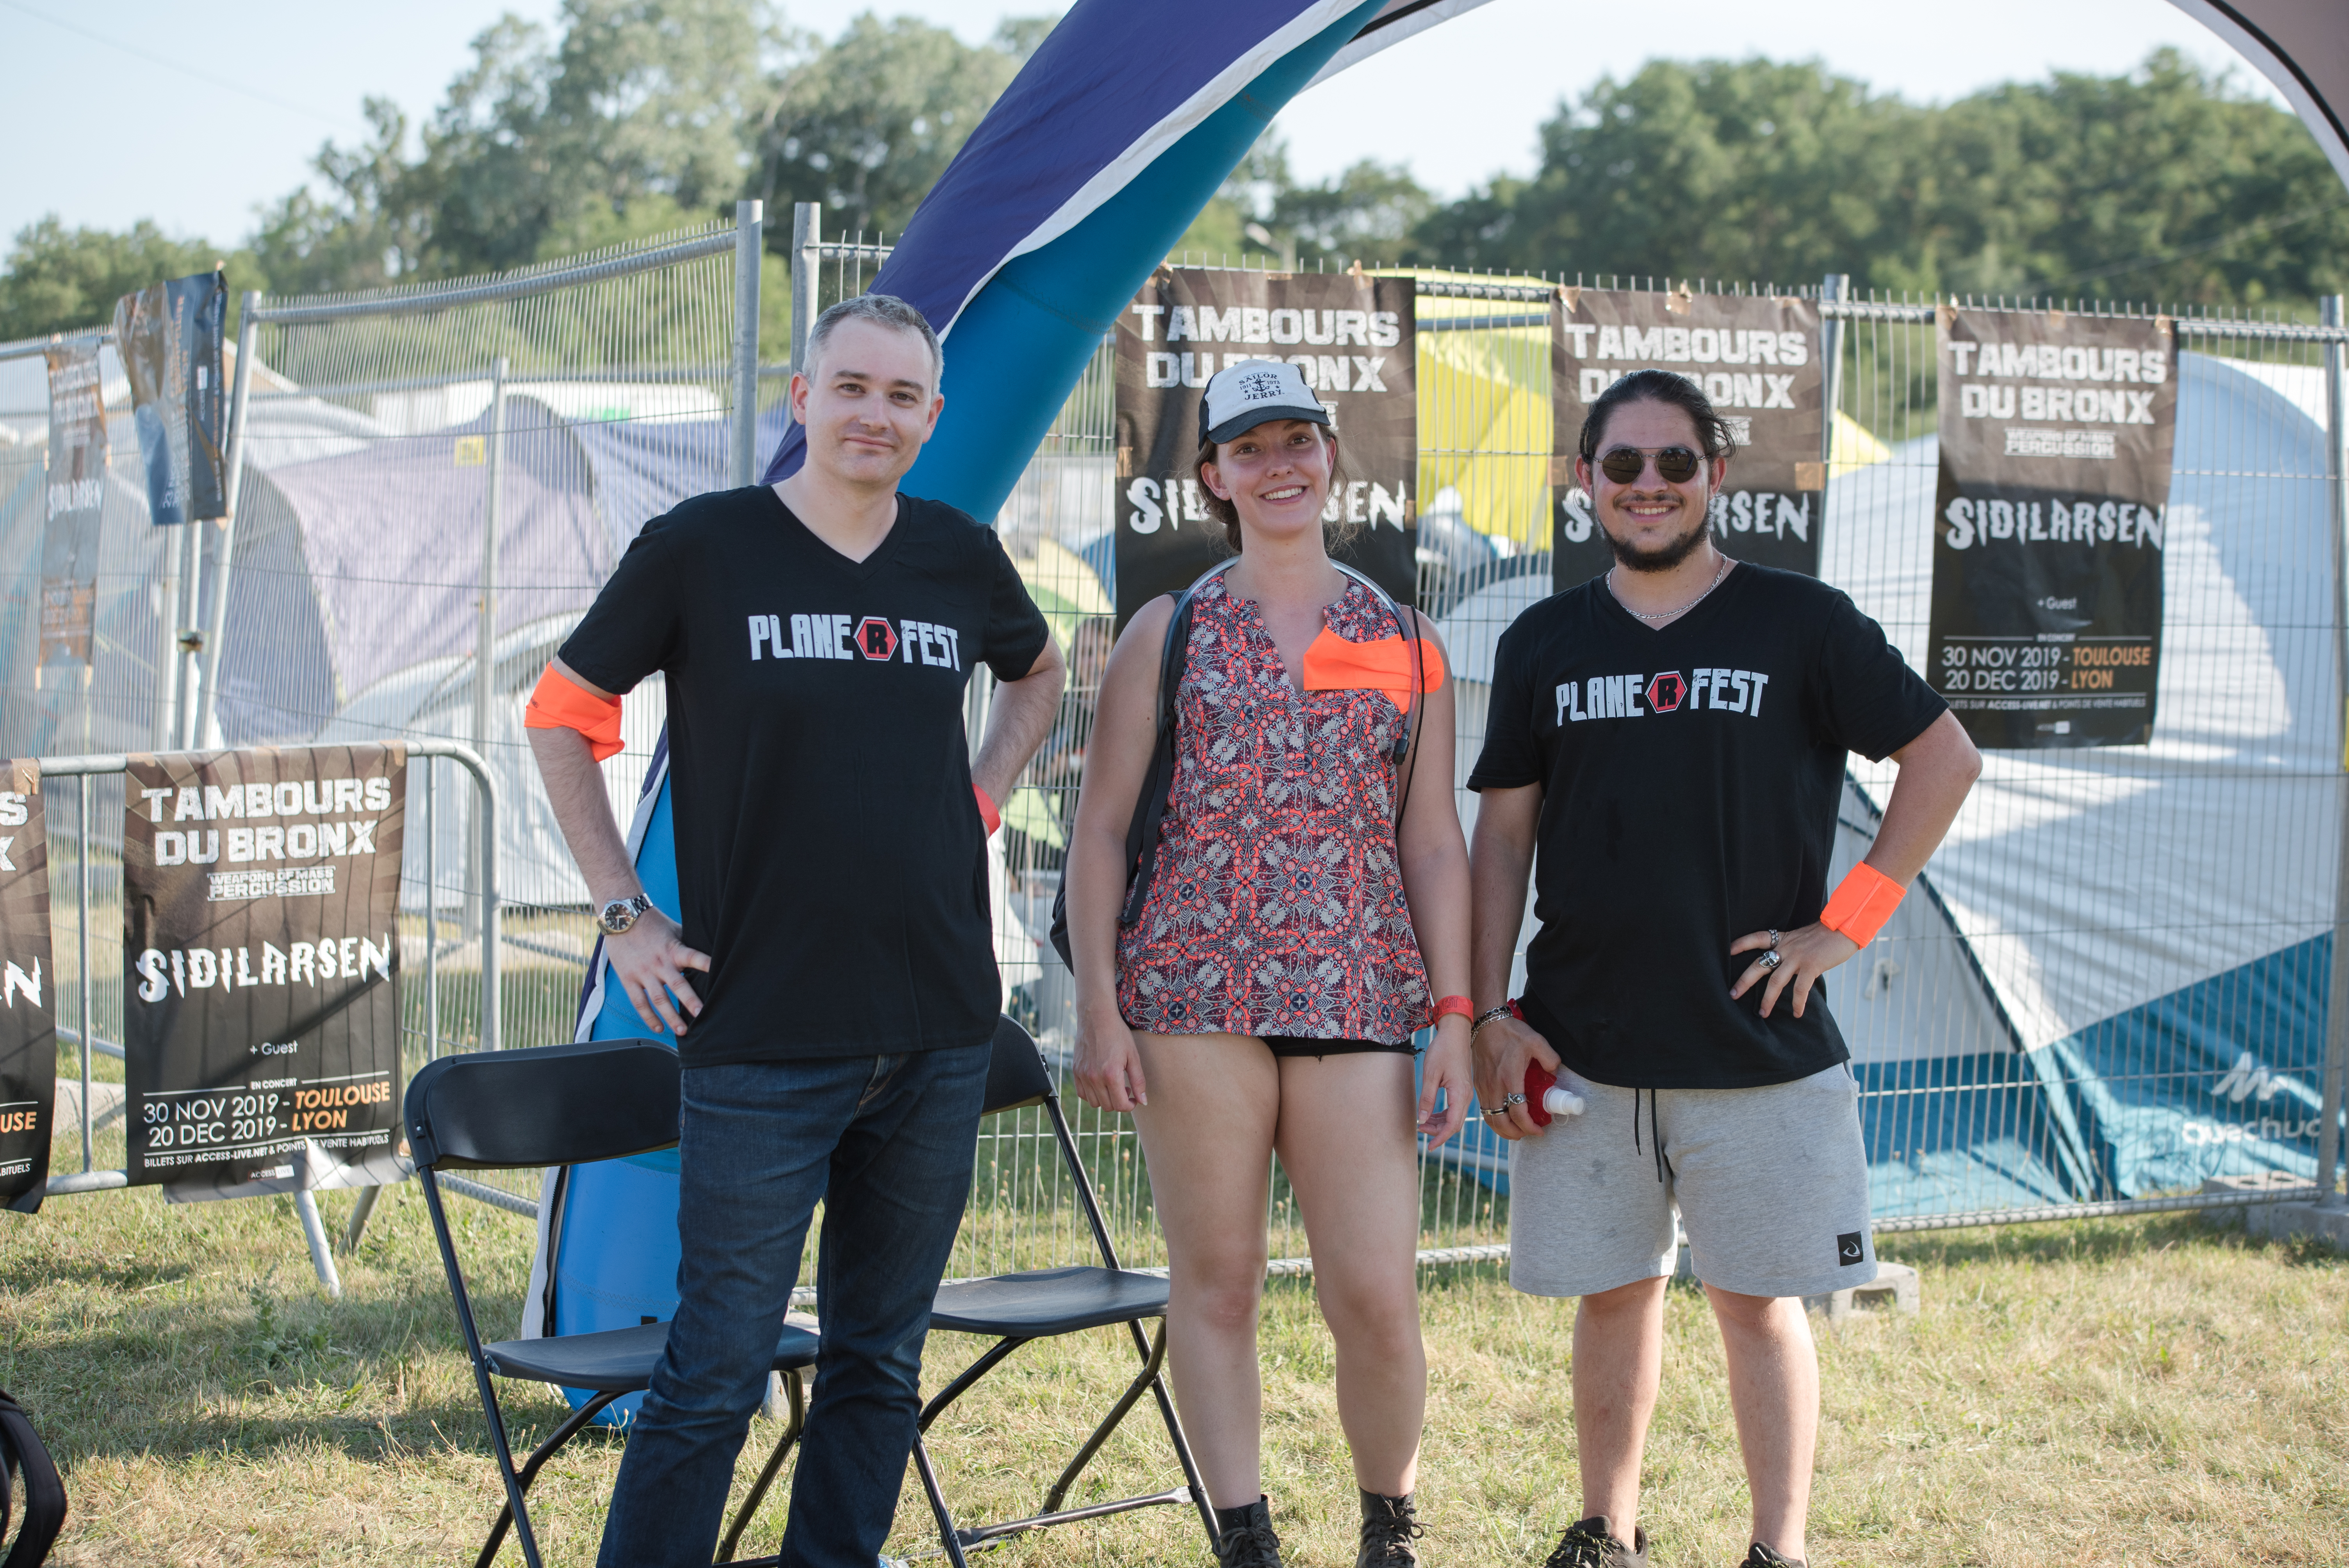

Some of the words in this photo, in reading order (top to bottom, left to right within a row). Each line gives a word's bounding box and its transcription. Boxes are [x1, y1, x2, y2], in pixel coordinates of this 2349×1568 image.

[1132, 305, 1400, 347] TAMBOURS
[1565, 323, 1809, 366] TAMBOURS
[1947, 341, 2167, 383] TAMBOURS
[1223, 354, 1388, 392] ONX
[1239, 373, 1278, 385] SAILOR
[1244, 389, 1281, 400] JERRY
[1961, 383, 2016, 419] DU
[2021, 386, 2155, 424] BRONX
[2006, 440, 2115, 456] PERCUSSION
[1944, 497, 2165, 551] SIDILARSEN
[2046, 596, 2077, 610] Guest
[1942, 646, 1967, 667] 30
[1971, 646, 2018, 668] NOV
[2020, 646, 2062, 667] 2019
[2073, 646, 2152, 666] TOULOUSE
[1944, 669, 1971, 690] 20
[1974, 670, 2017, 691] DEC
[2020, 670, 2060, 691] 2019
[2071, 669, 2114, 690] LYON
[141, 777, 391, 823] TAMBOURS
[155, 829, 219, 866] DU
[228, 820, 378, 863] BRONX
[210, 871, 275, 885] WEAPONS
[277, 871, 294, 881] OF
[296, 868, 333, 880] MASS
[210, 878, 334, 898] PERCUSSION
[135, 932, 391, 1003] SIDILARSEN
[261, 1040, 298, 1055] Guest
[251, 1081, 261, 1090] EN
[263, 1078, 297, 1089] CONCERT
[143, 1103, 169, 1123] 30
[175, 1098, 226, 1121] NOV
[232, 1093, 279, 1117] 2019
[294, 1081, 390, 1110] TOULOUSE
[149, 1125, 174, 1147] 20
[180, 1121, 225, 1145] DEC
[231, 1115, 276, 1140] 2019
[292, 1109, 347, 1131] LYON
[144, 1157, 175, 1168] BILLETS
[176, 1155, 193, 1165] SUR
[194, 1146, 268, 1163] ACCESS-LIVE.NET
[277, 1140, 306, 1153] POINTS
[320, 1137, 348, 1149] VENTE
[349, 1133, 389, 1147] HABITUELS
[250, 1169, 275, 1178] ACCESS
